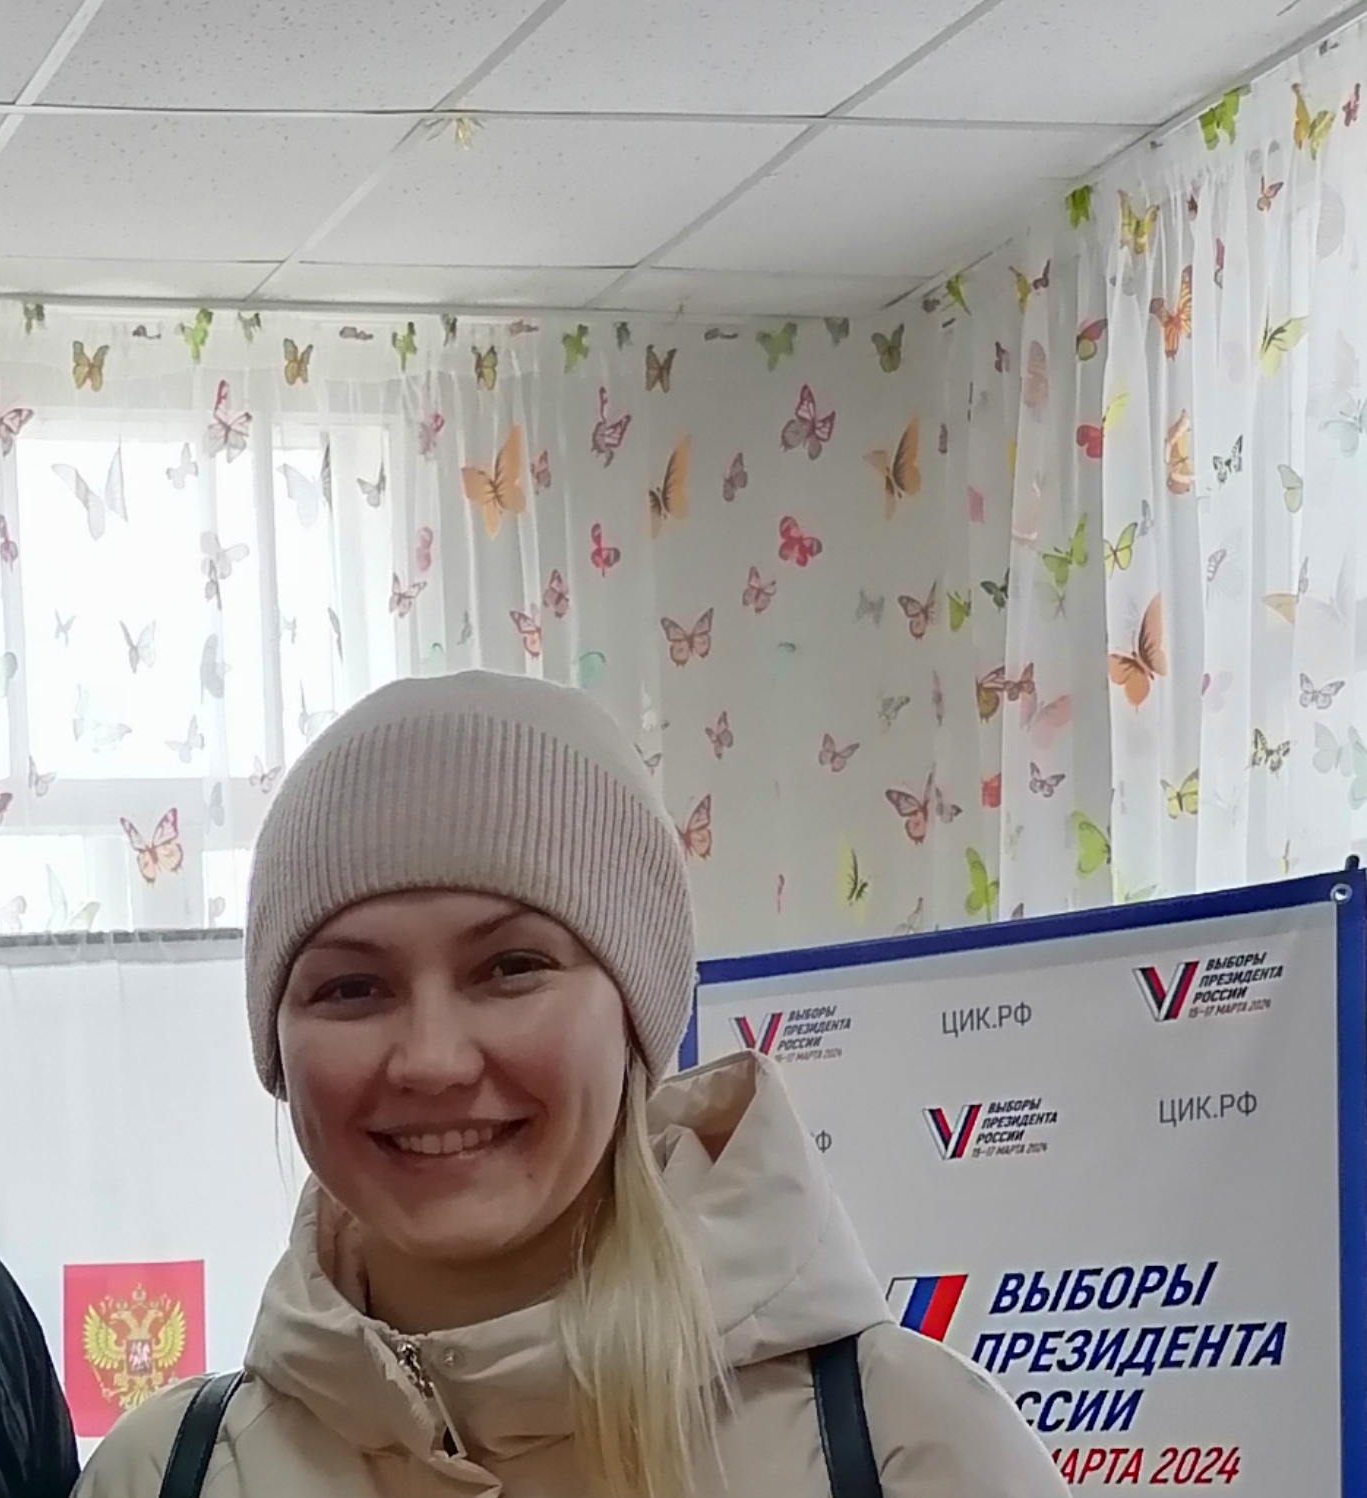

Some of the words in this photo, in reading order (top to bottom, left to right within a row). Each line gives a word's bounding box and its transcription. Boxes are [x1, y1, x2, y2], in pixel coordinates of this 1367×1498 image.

[1205, 951, 1268, 971] ВЫБОРЫ
[1198, 965, 1284, 988] ПРЕЗИДЕНТА
[1192, 986, 1248, 1004] РОССИИ
[787, 1005, 837, 1022] ВЫБОРЫ
[942, 1001, 1032, 1038] ЦИК.РФ
[782, 1018, 852, 1036] ПРЕЗИДЕНТА
[777, 1036, 822, 1051] РОССИИ
[987, 1098, 1042, 1114] ВЫБОРЫ
[1159, 1090, 1257, 1127] ЦИК.РФ
[981, 1111, 1058, 1129] ПРЕЗИДЕНТА
[976, 1130, 1025, 1144] РОССИИ
[988, 1261, 1219, 1315] ВЫБОРЫ
[971, 1321, 1287, 1377] ПРЕЗИДЕНТА
[1015, 1388, 1144, 1433] ССИИ
[1051, 1447, 1144, 1484] АРТА
[1148, 1446, 1242, 1484] 2024
